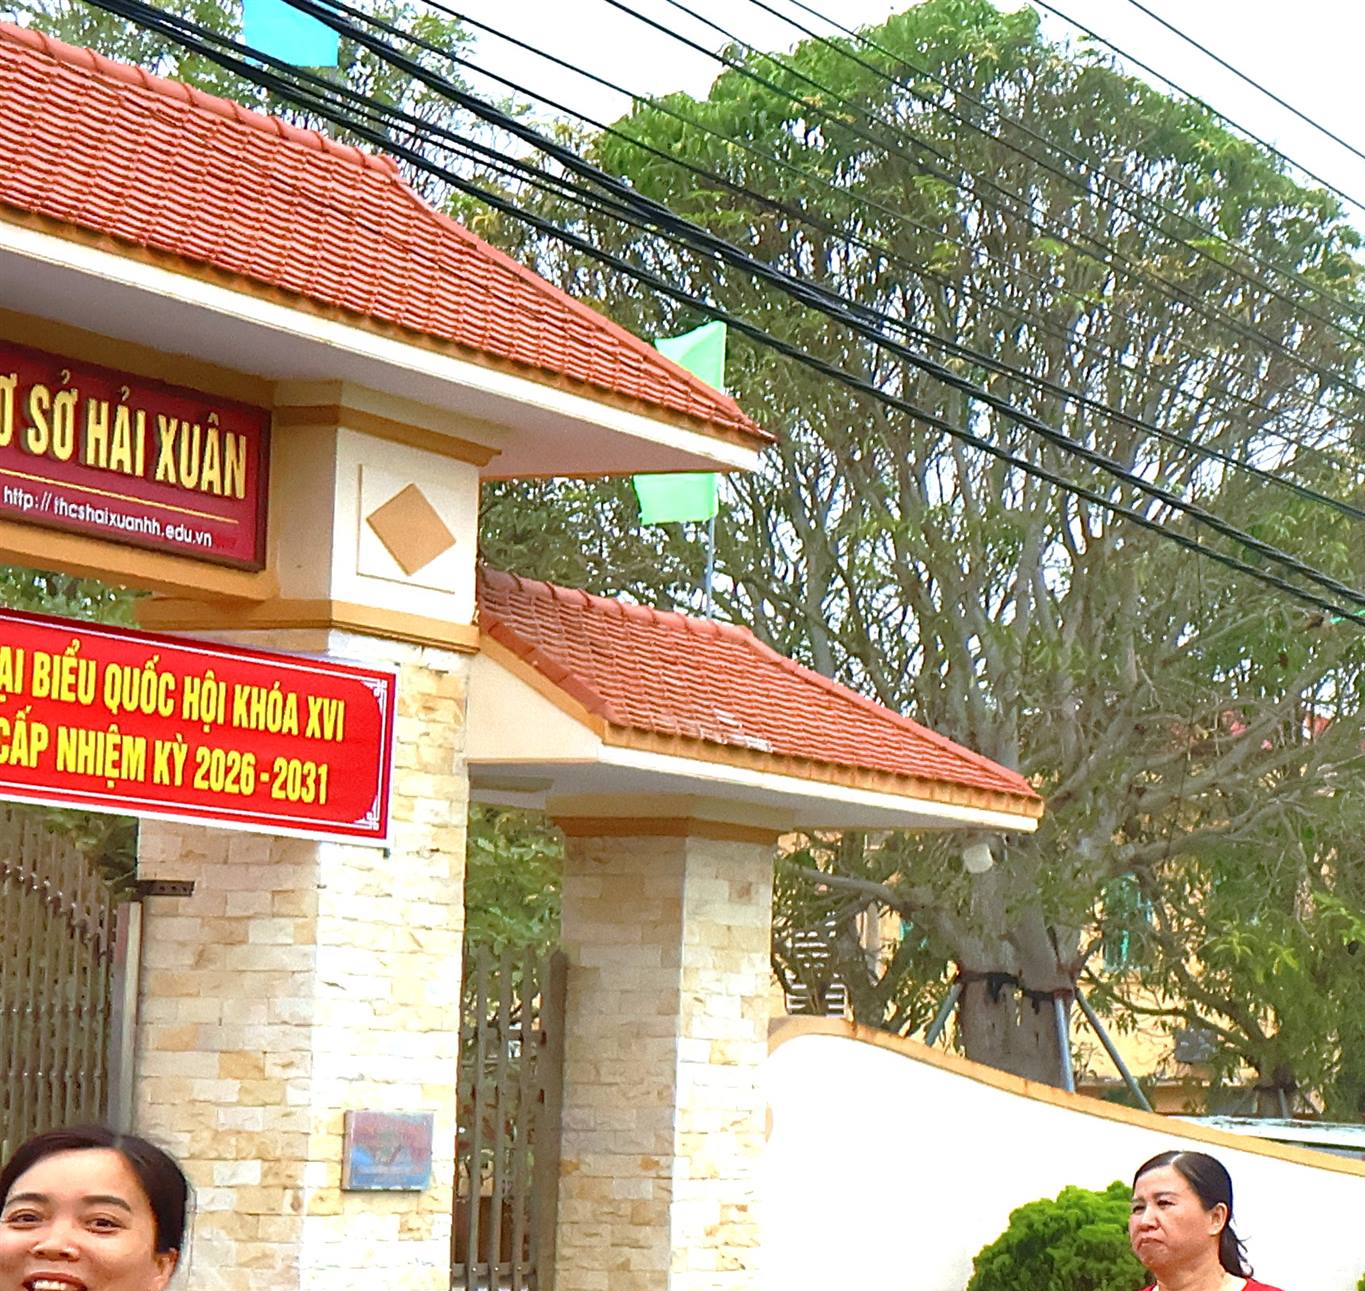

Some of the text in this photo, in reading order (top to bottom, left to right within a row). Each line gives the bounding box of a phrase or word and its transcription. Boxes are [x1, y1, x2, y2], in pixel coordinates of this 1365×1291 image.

[27, 369, 78, 460] SỞ
[86, 385, 146, 477] HẢI
[155, 412, 246, 499] XUÂN
[31, 638, 97, 706] BIỂU
[103, 654, 176, 718] QUỐC
[181, 669, 227, 734] HỘI
[232, 680, 299, 737] KHÓA
[304, 695, 345, 743] XVI
[56, 723, 147, 789] NHIỆM
[152, 732, 188, 787] KỲ
